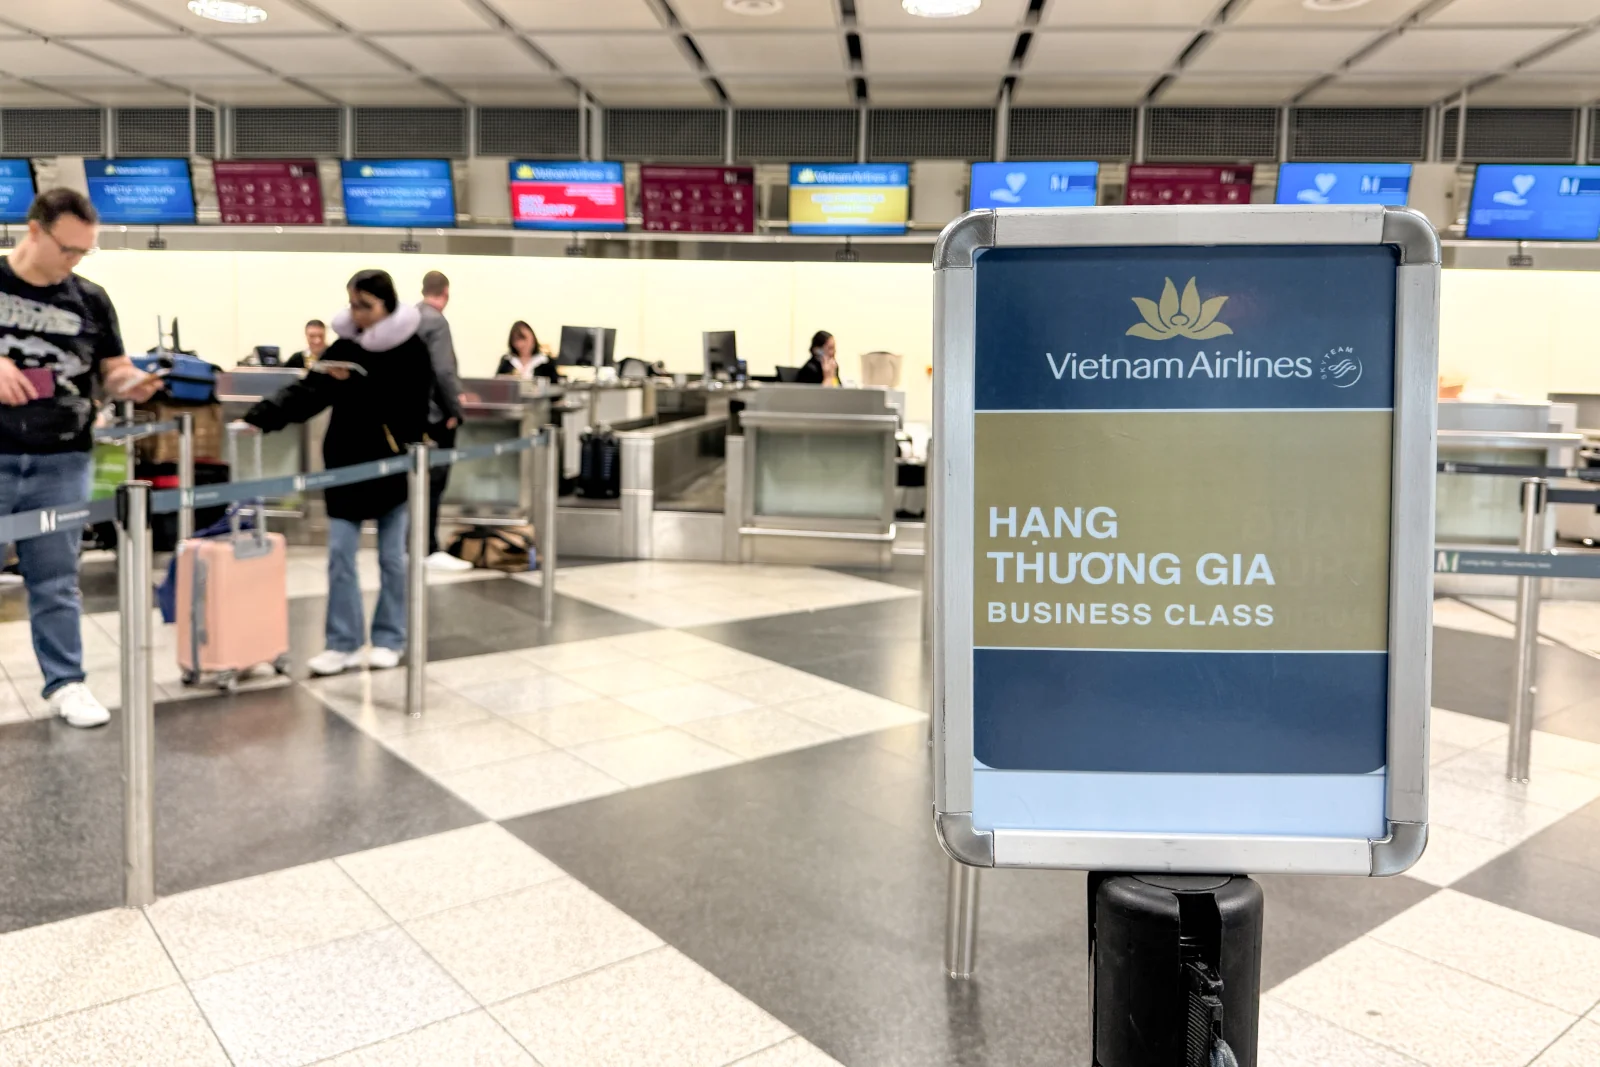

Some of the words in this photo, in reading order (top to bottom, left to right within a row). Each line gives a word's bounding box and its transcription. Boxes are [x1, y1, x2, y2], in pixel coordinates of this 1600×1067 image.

[1046, 352, 1183, 380] Vietnam
[1187, 349, 1313, 379] Airlines
[1319, 346, 1354, 380] SKYTEAM
[989, 506, 1118, 546] HẠNG
[987, 551, 1182, 586] THƯƠNG
[1195, 552, 1277, 586] GIA
[988, 601, 1152, 626] BUSINESS
[1164, 603, 1275, 627] CLASS
